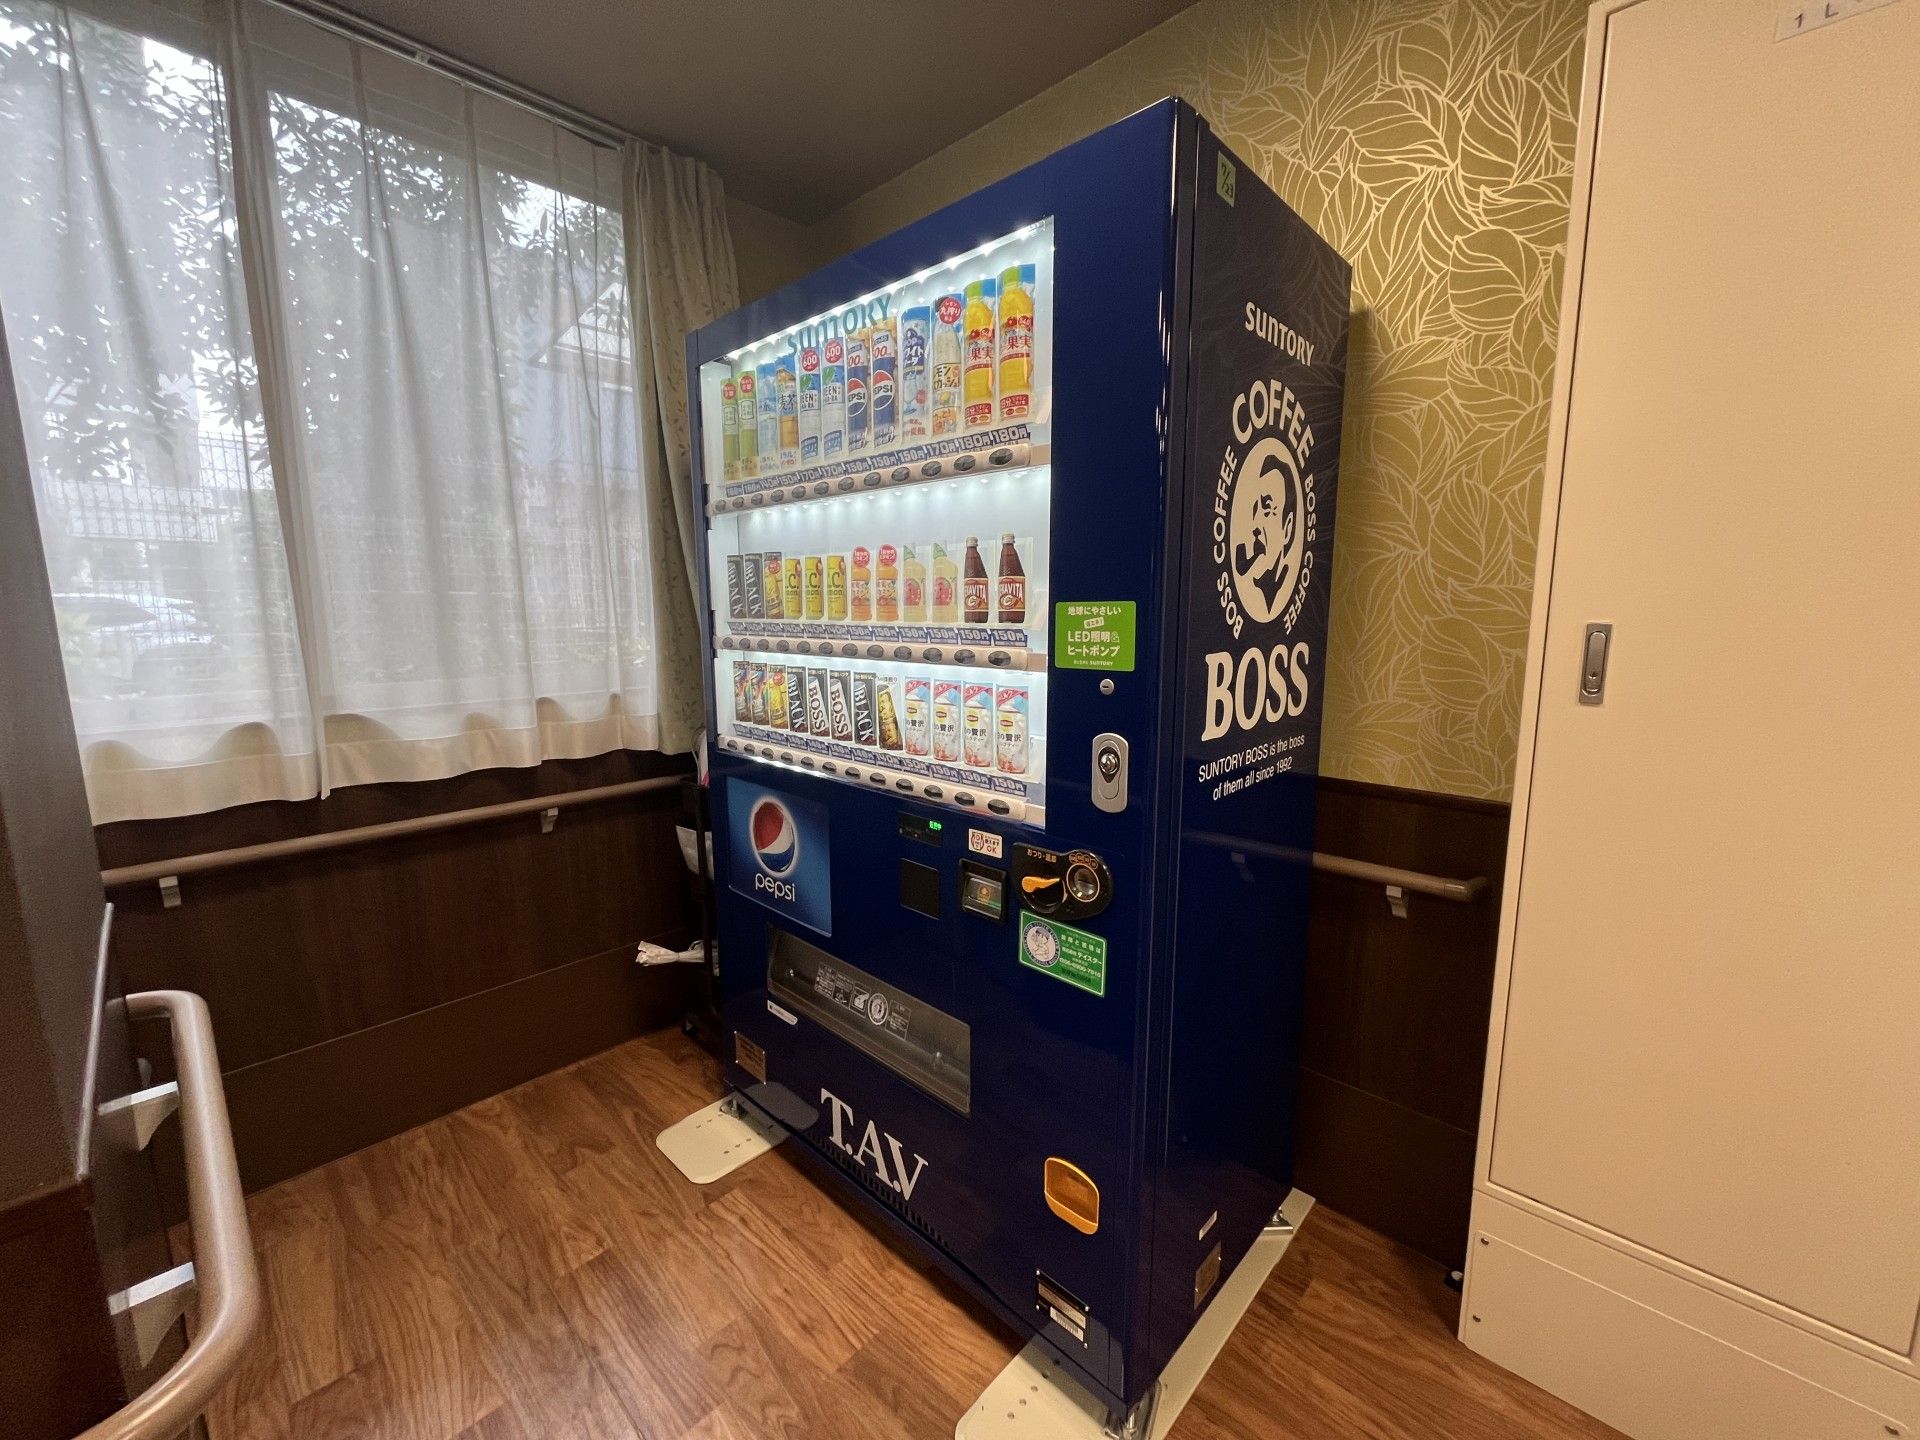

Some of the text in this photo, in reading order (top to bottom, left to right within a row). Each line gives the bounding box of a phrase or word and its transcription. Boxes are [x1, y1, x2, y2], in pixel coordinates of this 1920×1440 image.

[1008, 335, 1031, 350] 果実
[1245, 302, 1314, 367] SUNTORY
[803, 356, 818, 367] 600
[826, 346, 841, 359] 600
[848, 391, 866, 402] EPSI
[874, 384, 893, 396] EPSI
[994, 426, 1027, 443] 180円
[1232, 379, 1315, 469] COFFEE
[1213, 445, 1243, 639] BOSS COFFEE
[1283, 473, 1317, 635] BOSS COFFEE
[1068, 606, 1121, 616] 地球にやさしい
[993, 630, 1025, 641] 150円
[1068, 645, 1120, 657] ヒートポンプ
[1201, 642, 1309, 742] BOSS
[809, 686, 826, 730] BOSS
[831, 689, 849, 734] BOSS
[854, 684, 874, 741] BLACK
[1199, 735, 1305, 782] SUNTORY BOSS is the boss
[1213, 756, 1293, 801] of them all since 1992
[986, 845, 997, 854] OK
[755, 873, 795, 901] pepsi
